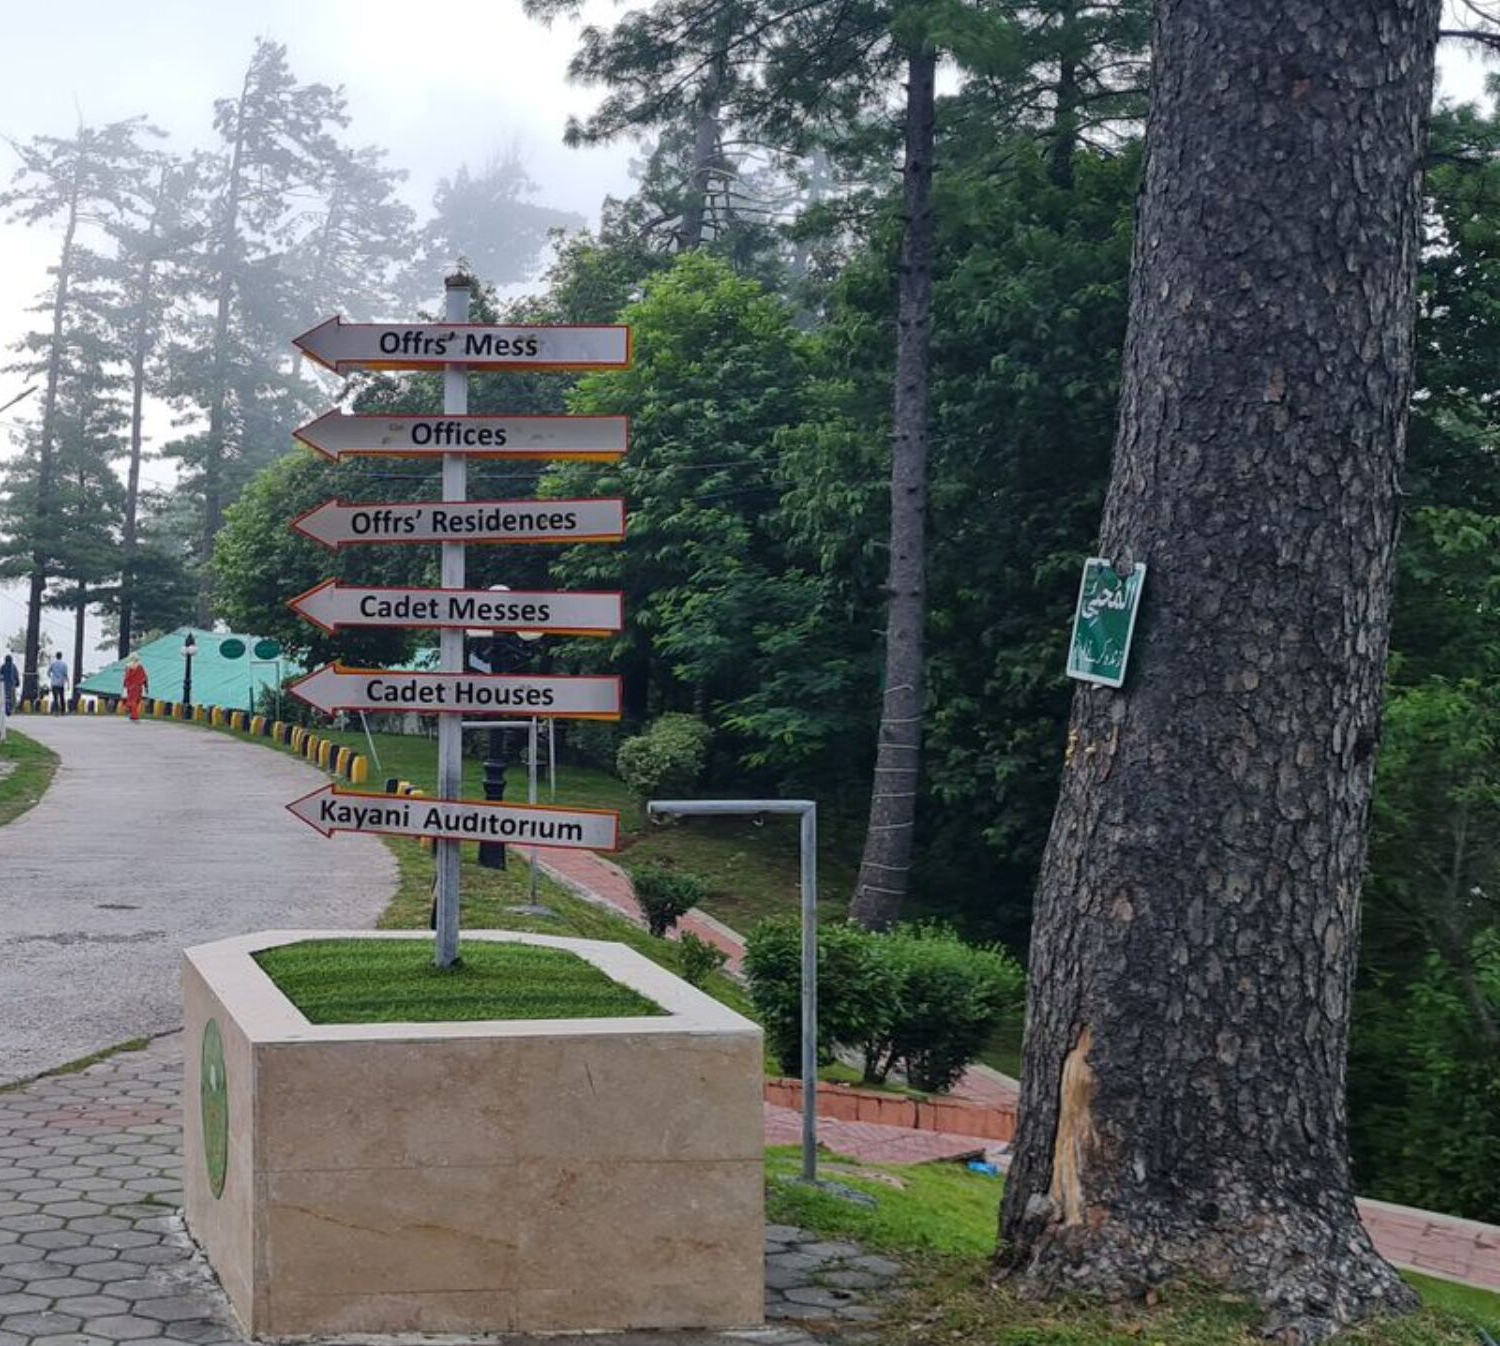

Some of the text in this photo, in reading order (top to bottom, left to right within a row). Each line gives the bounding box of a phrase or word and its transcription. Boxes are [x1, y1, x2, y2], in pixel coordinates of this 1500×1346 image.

[464, 333, 539, 357] Mess
[411, 421, 507, 446] Offices
[431, 508, 577, 534] Residences
[359, 594, 550, 622] Cadet Messes
[366, 679, 554, 706] Cadet Houses
[320, 799, 410, 828] Kayani
